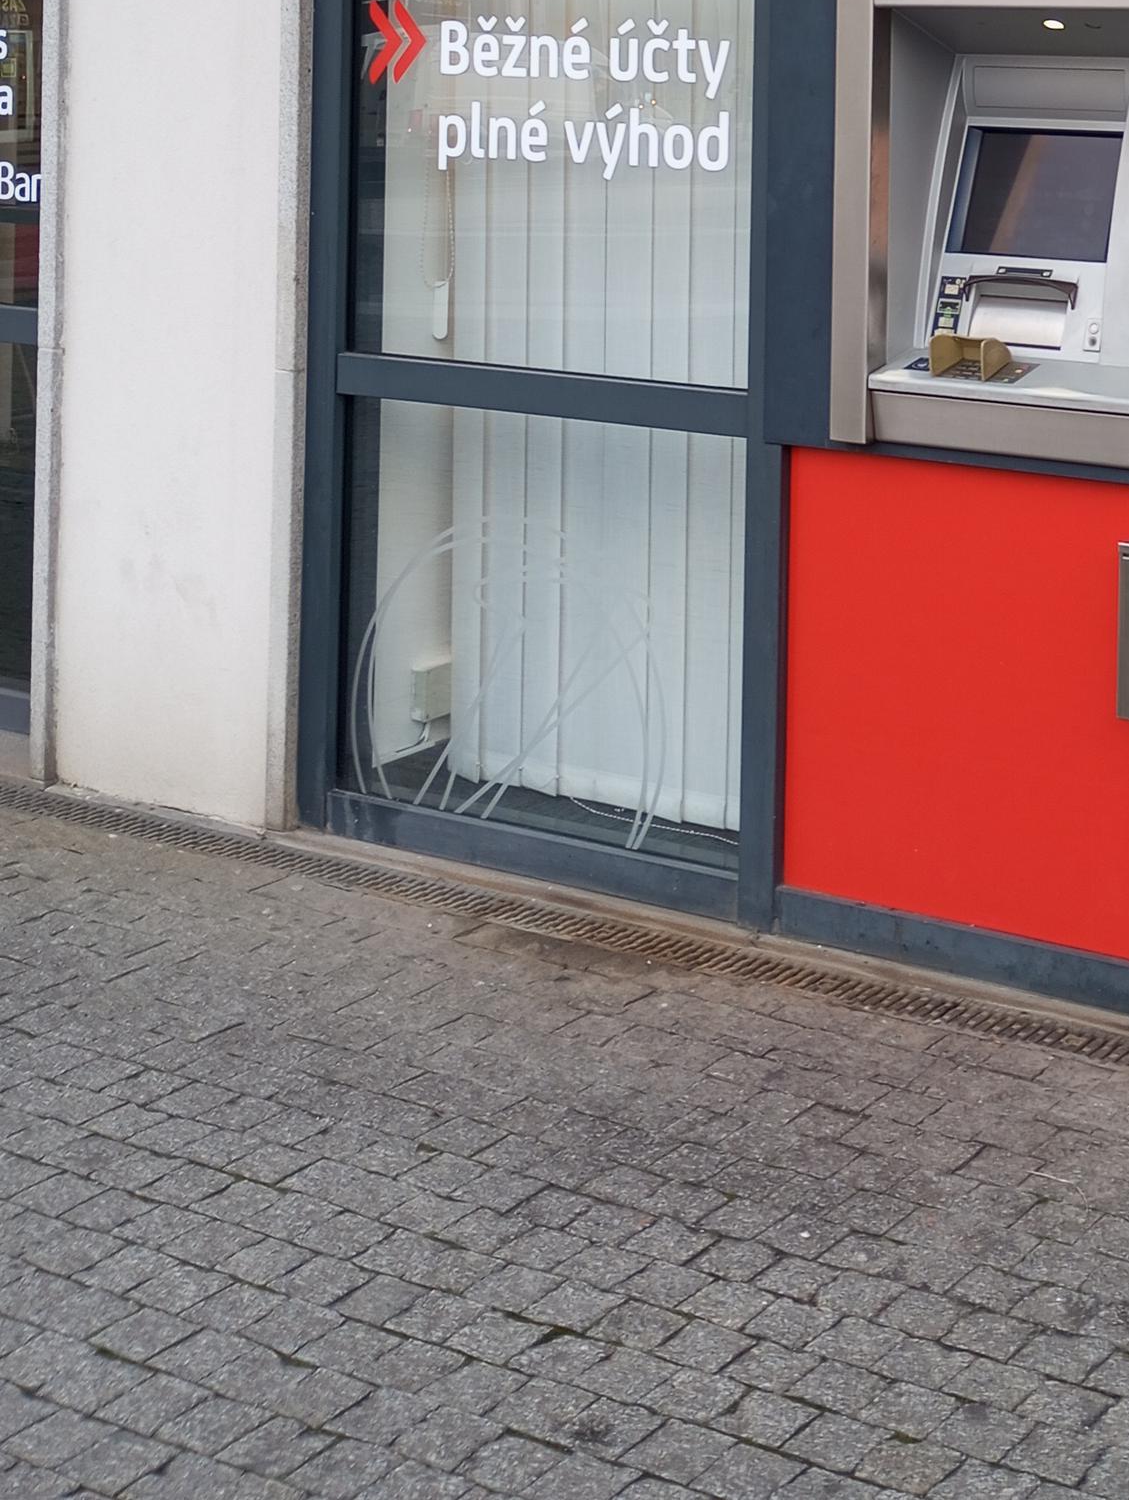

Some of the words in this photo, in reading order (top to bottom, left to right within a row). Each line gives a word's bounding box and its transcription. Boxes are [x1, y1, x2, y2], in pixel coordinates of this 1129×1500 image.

[440, 16, 590, 80] Běžné
[610, 19, 730, 99] účty
[438, 100, 548, 170] plné
[564, 103, 729, 180] výhod
